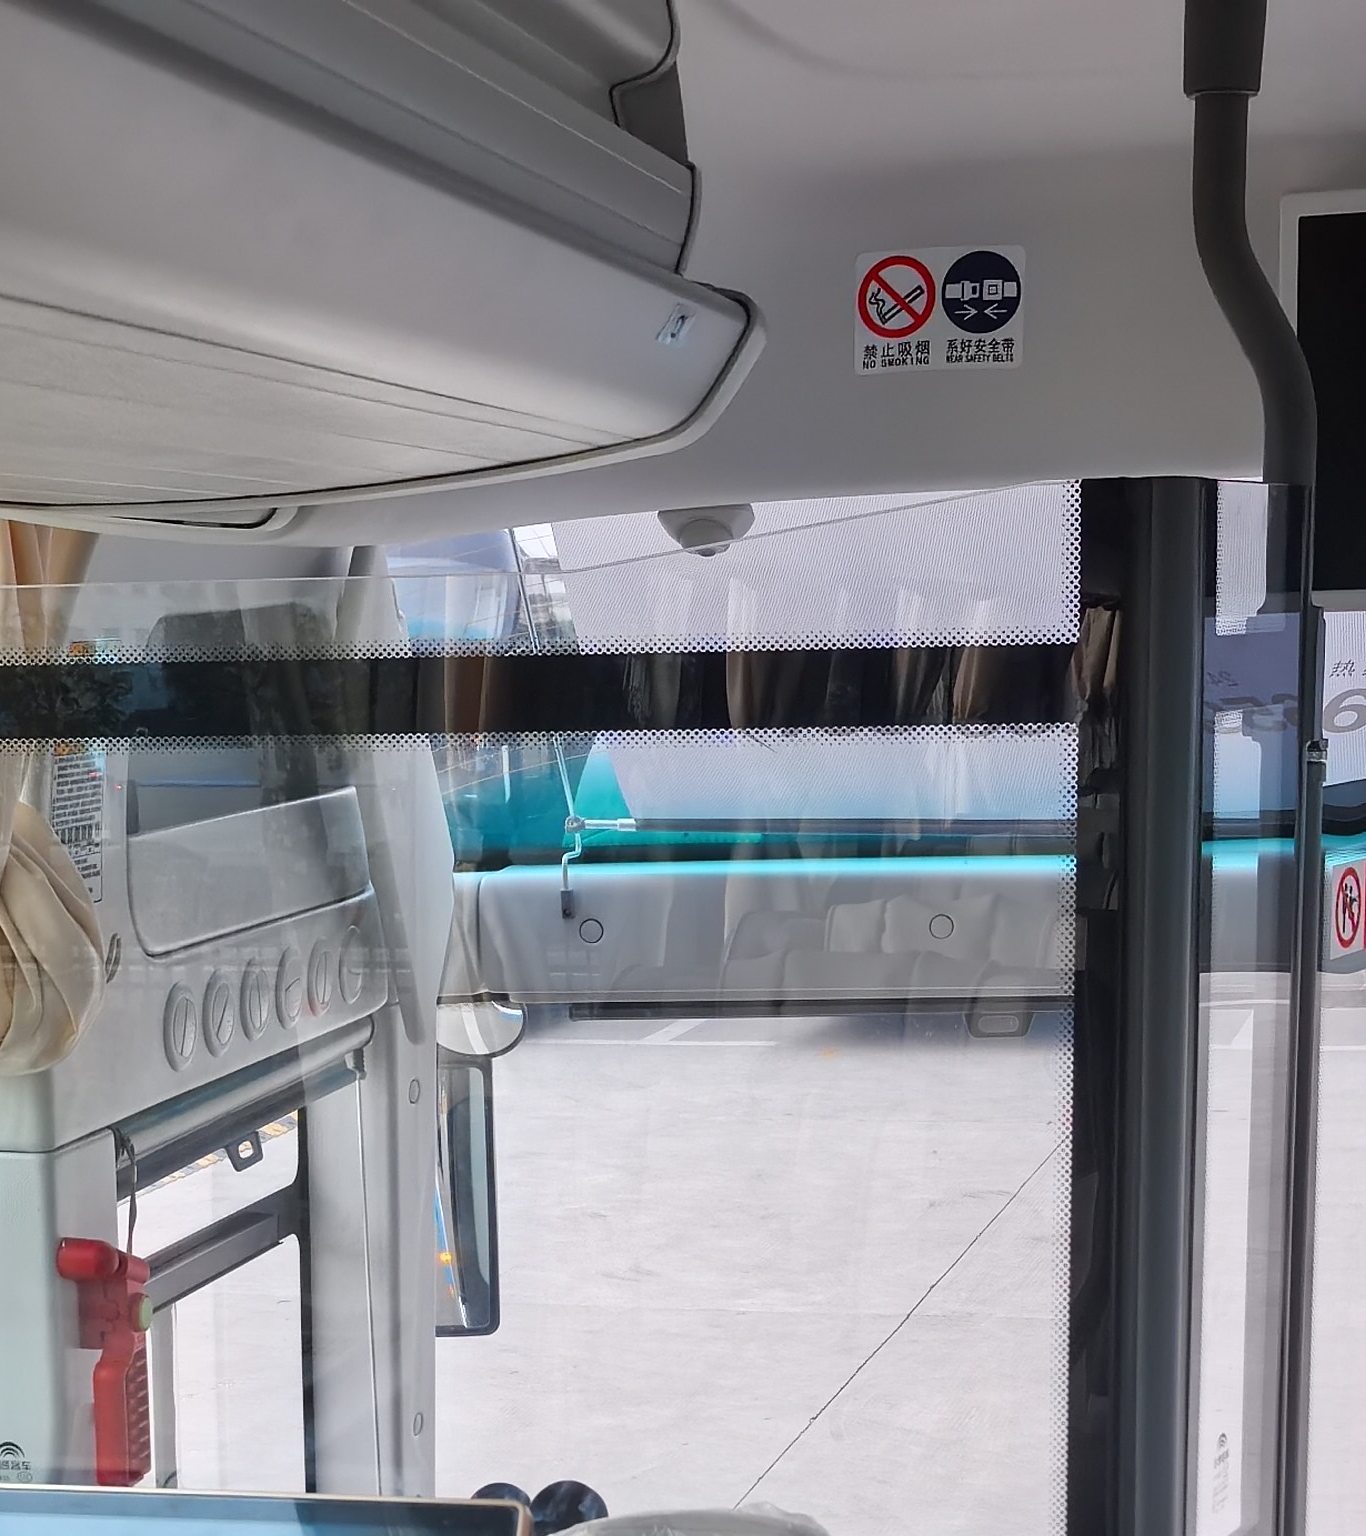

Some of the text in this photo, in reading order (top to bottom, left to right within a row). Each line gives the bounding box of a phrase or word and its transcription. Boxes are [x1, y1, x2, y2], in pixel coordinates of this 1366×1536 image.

[863, 341, 931, 359] 禁止吸烟
[946, 338, 1015, 354] 系好安全带
[863, 356, 930, 370] NO SMOKING
